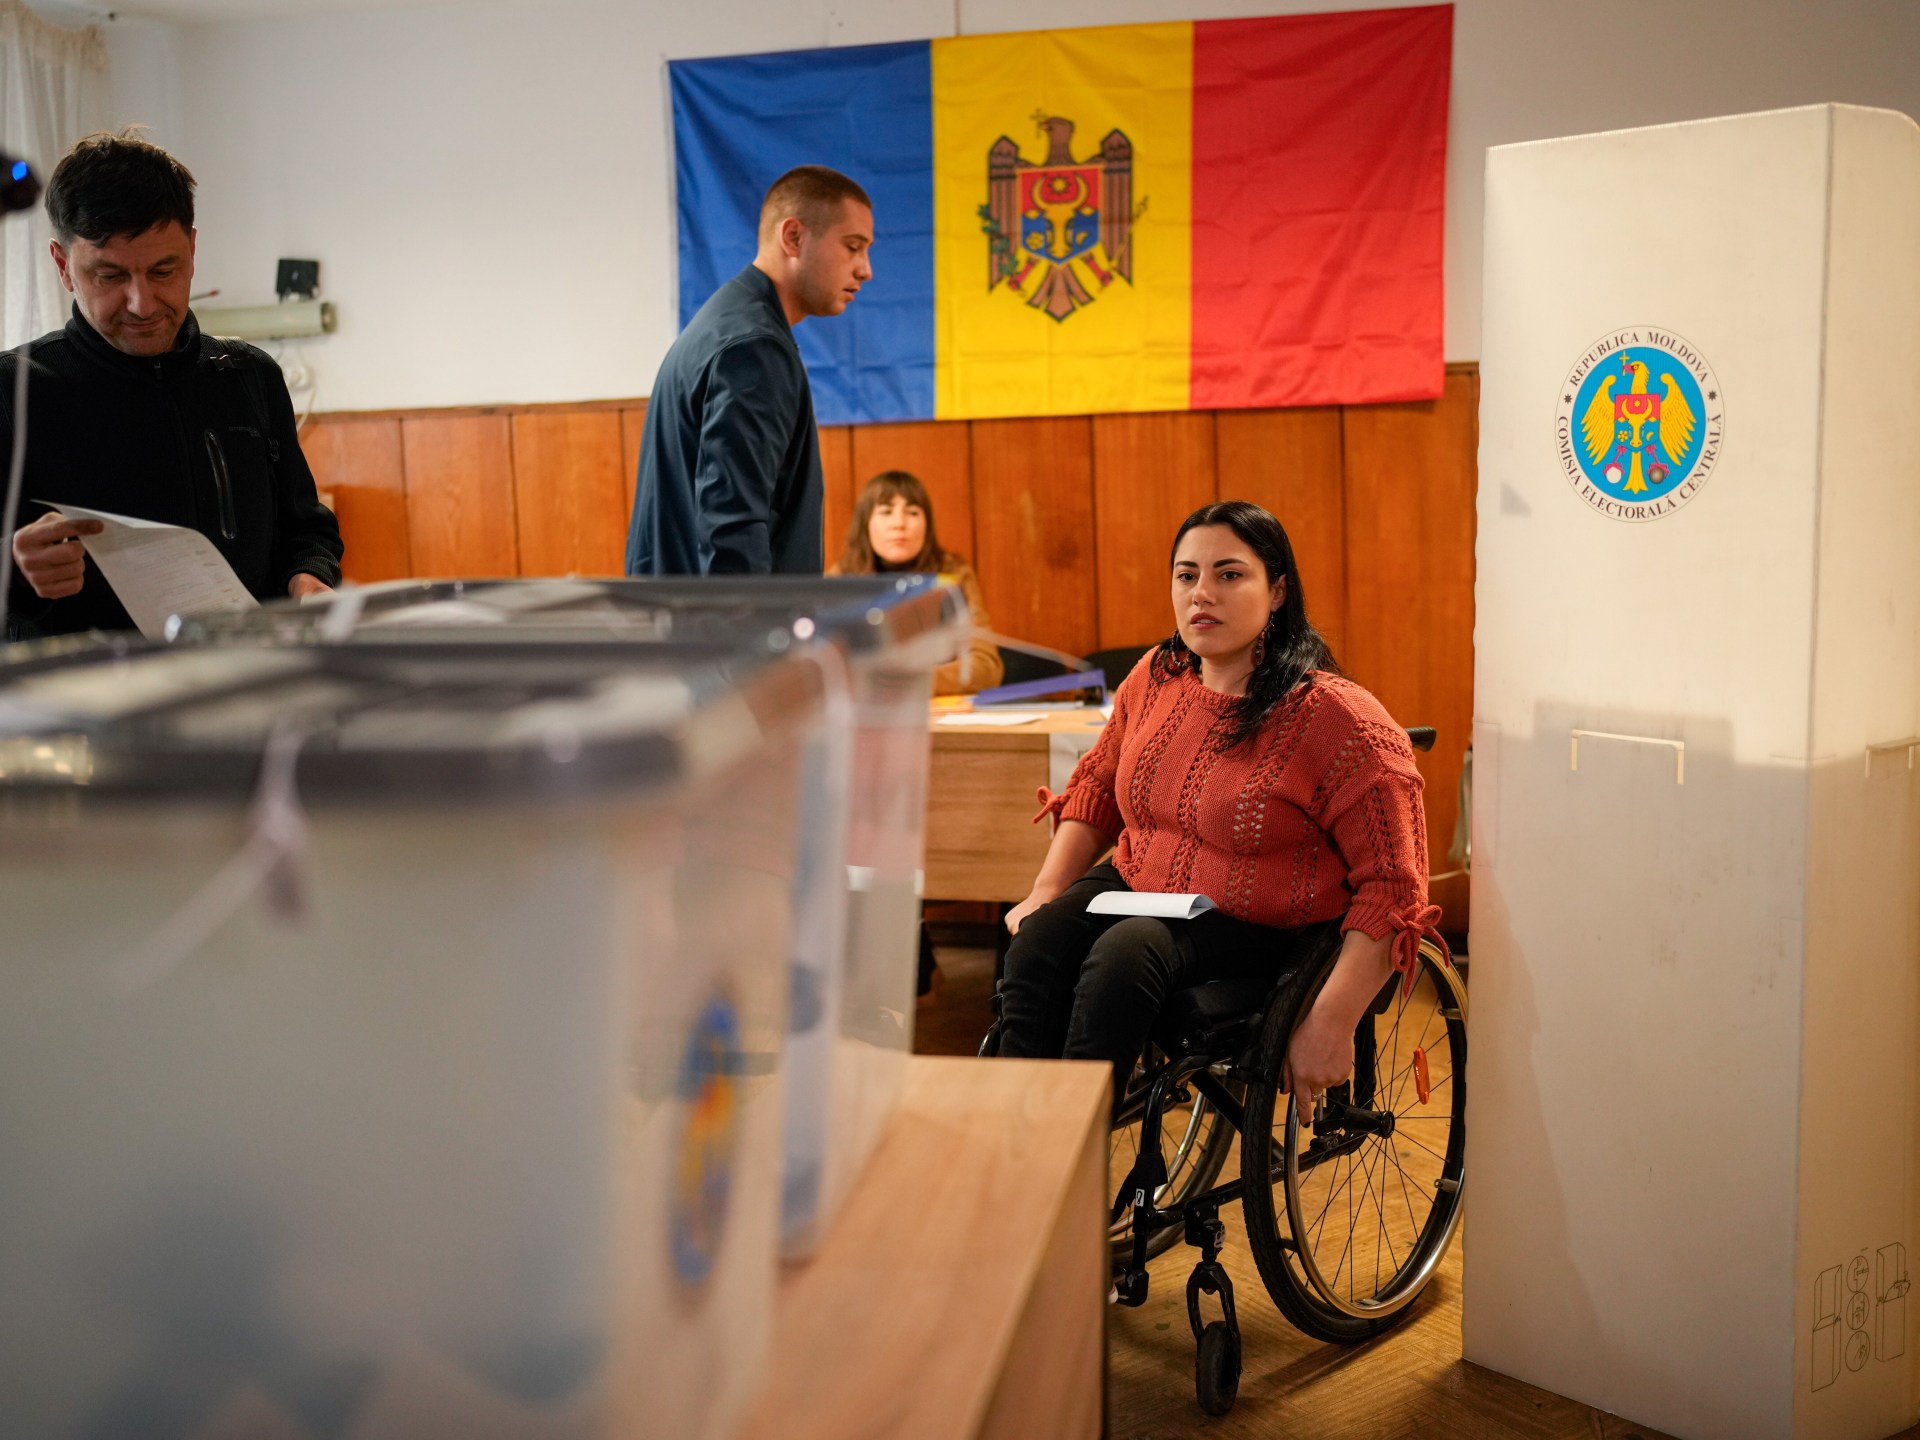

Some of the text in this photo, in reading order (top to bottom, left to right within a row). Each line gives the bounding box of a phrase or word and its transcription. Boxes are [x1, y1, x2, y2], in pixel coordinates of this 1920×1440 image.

[1569, 331, 1708, 387] REPUBLICA MOLDOVA
[1557, 413, 1722, 519] COMISIA ELECTORALĂ CENTRALĂ
